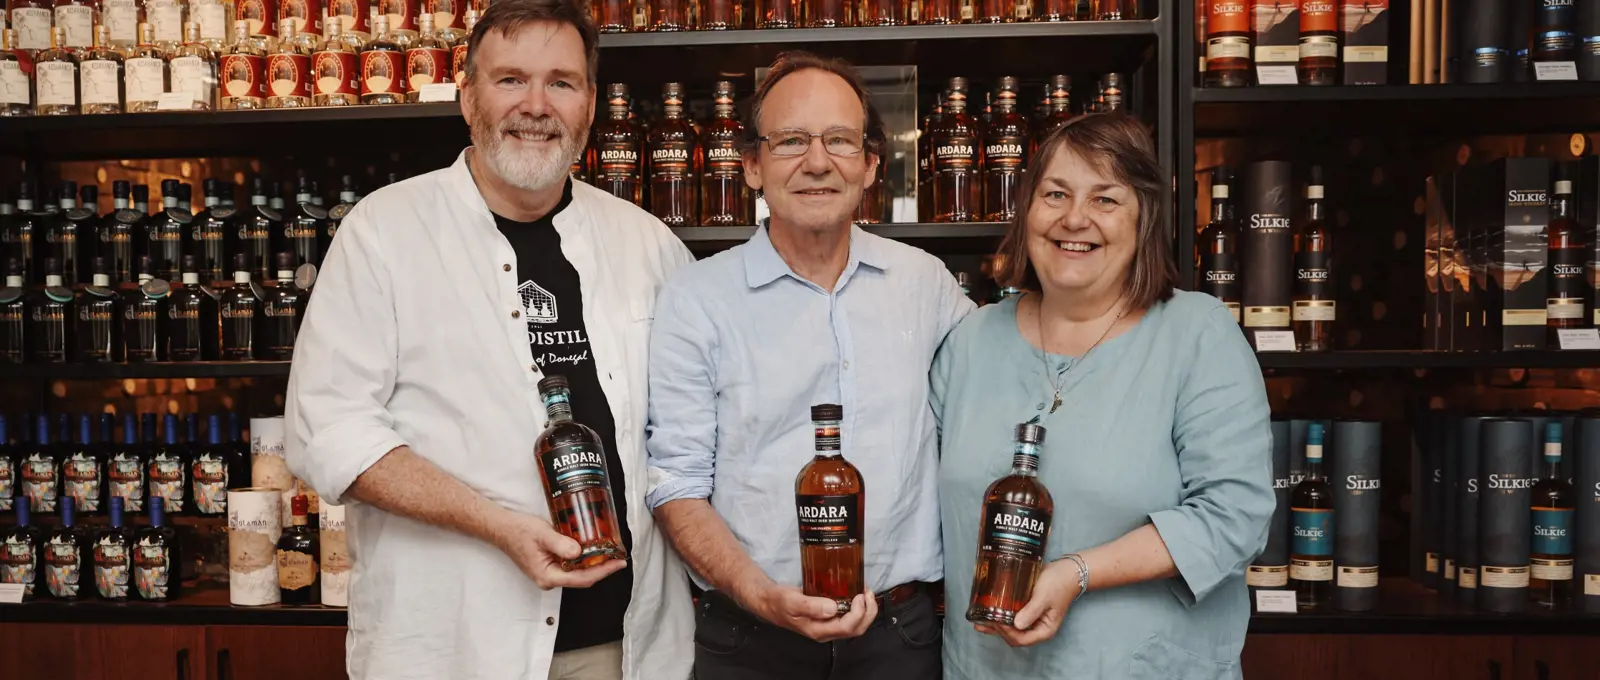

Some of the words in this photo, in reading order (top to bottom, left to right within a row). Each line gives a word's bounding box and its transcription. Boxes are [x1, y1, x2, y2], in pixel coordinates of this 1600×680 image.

[601, 150, 637, 160] ARDARA
[653, 149, 688, 159] ARDARA
[937, 144, 973, 155] ARDARA
[986, 144, 1022, 154] ARDARA
[1508, 190, 1547, 202] SILKIE
[1250, 214, 1290, 229] SILKIE
[1206, 270, 1235, 281] SILKIE
[1298, 268, 1328, 279] SILKIE
[1553, 264, 1582, 275] SILKIE
[528, 330, 590, 345] DISTIL
[536, 353, 546, 367] of
[549, 350, 588, 365] Donegal
[553, 451, 603, 470] ARDARA
[1488, 474, 1531, 489] SILKIE
[799, 505, 848, 518] ARDARA
[993, 512, 1044, 534] ARDARA
[1294, 526, 1323, 538] SILKIE
[1534, 525, 1566, 537] SILKIE
